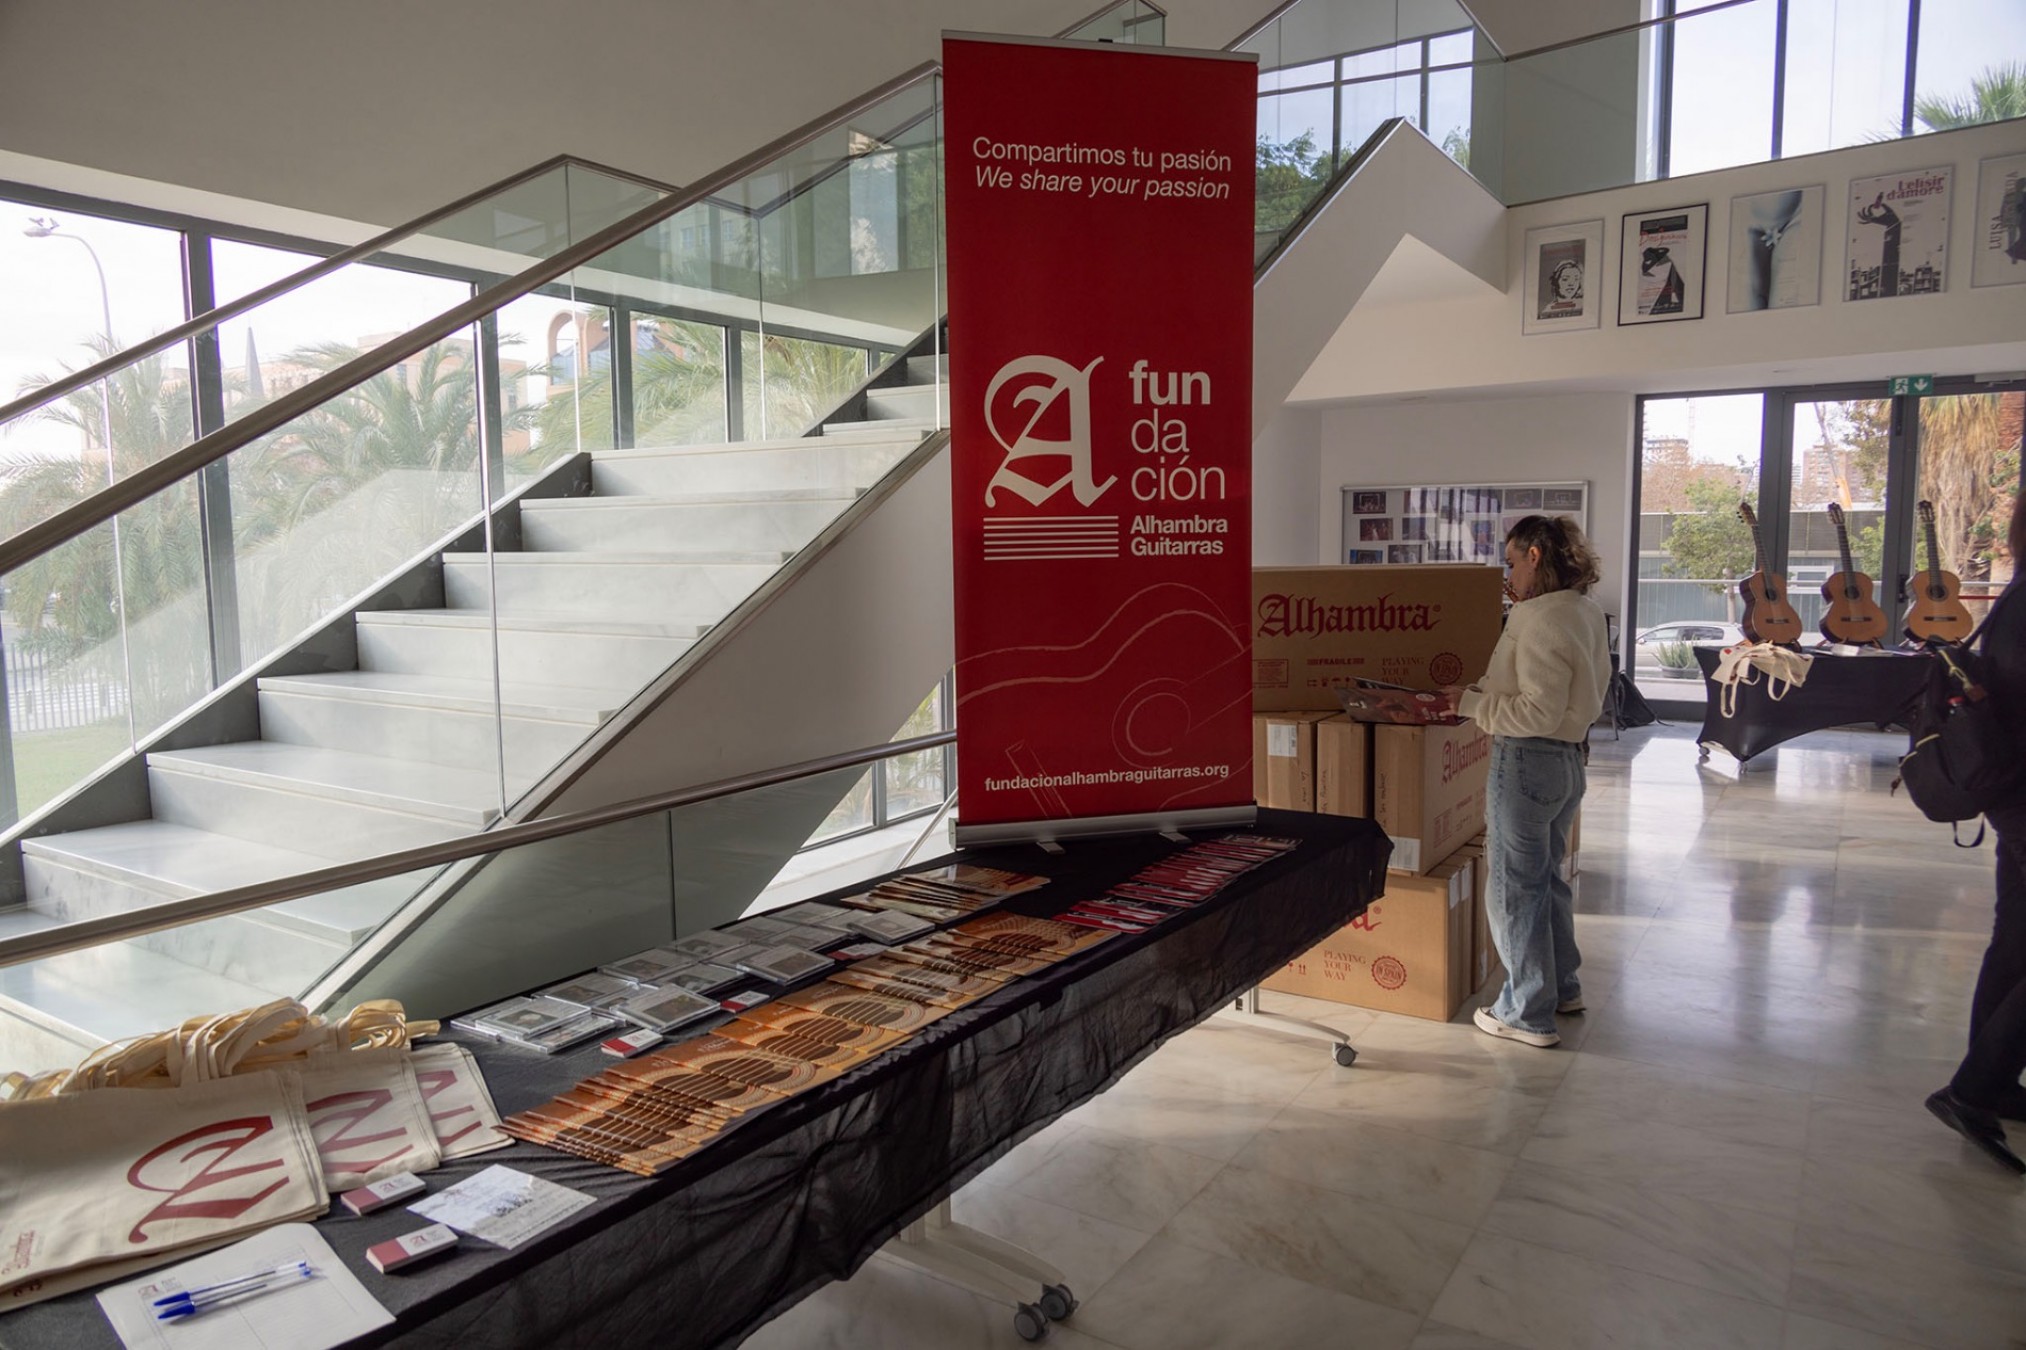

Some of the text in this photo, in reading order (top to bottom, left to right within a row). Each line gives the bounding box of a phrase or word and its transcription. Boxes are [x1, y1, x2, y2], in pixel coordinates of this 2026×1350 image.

[972, 136, 1232, 173] Compartimos tu pasión
[975, 165, 1230, 200] We share your passion
[1128, 359, 1211, 405] fun
[1131, 408, 1190, 453] da
[1131, 455, 1226, 501] ción
[1130, 514, 1228, 534] Alhambra
[1131, 537, 1224, 556] Guitarras
[1257, 592, 1441, 640] Alhambra
[1382, 656, 1425, 666] PLAYING
[1382, 667, 1409, 676] YOUR
[984, 764, 1230, 791] fundacionalhambraguitarras.org
[1323, 950, 1367, 965] PLAYING
[1323, 960, 1352, 972] YOUR
[1323, 970, 1347, 981] WAY
